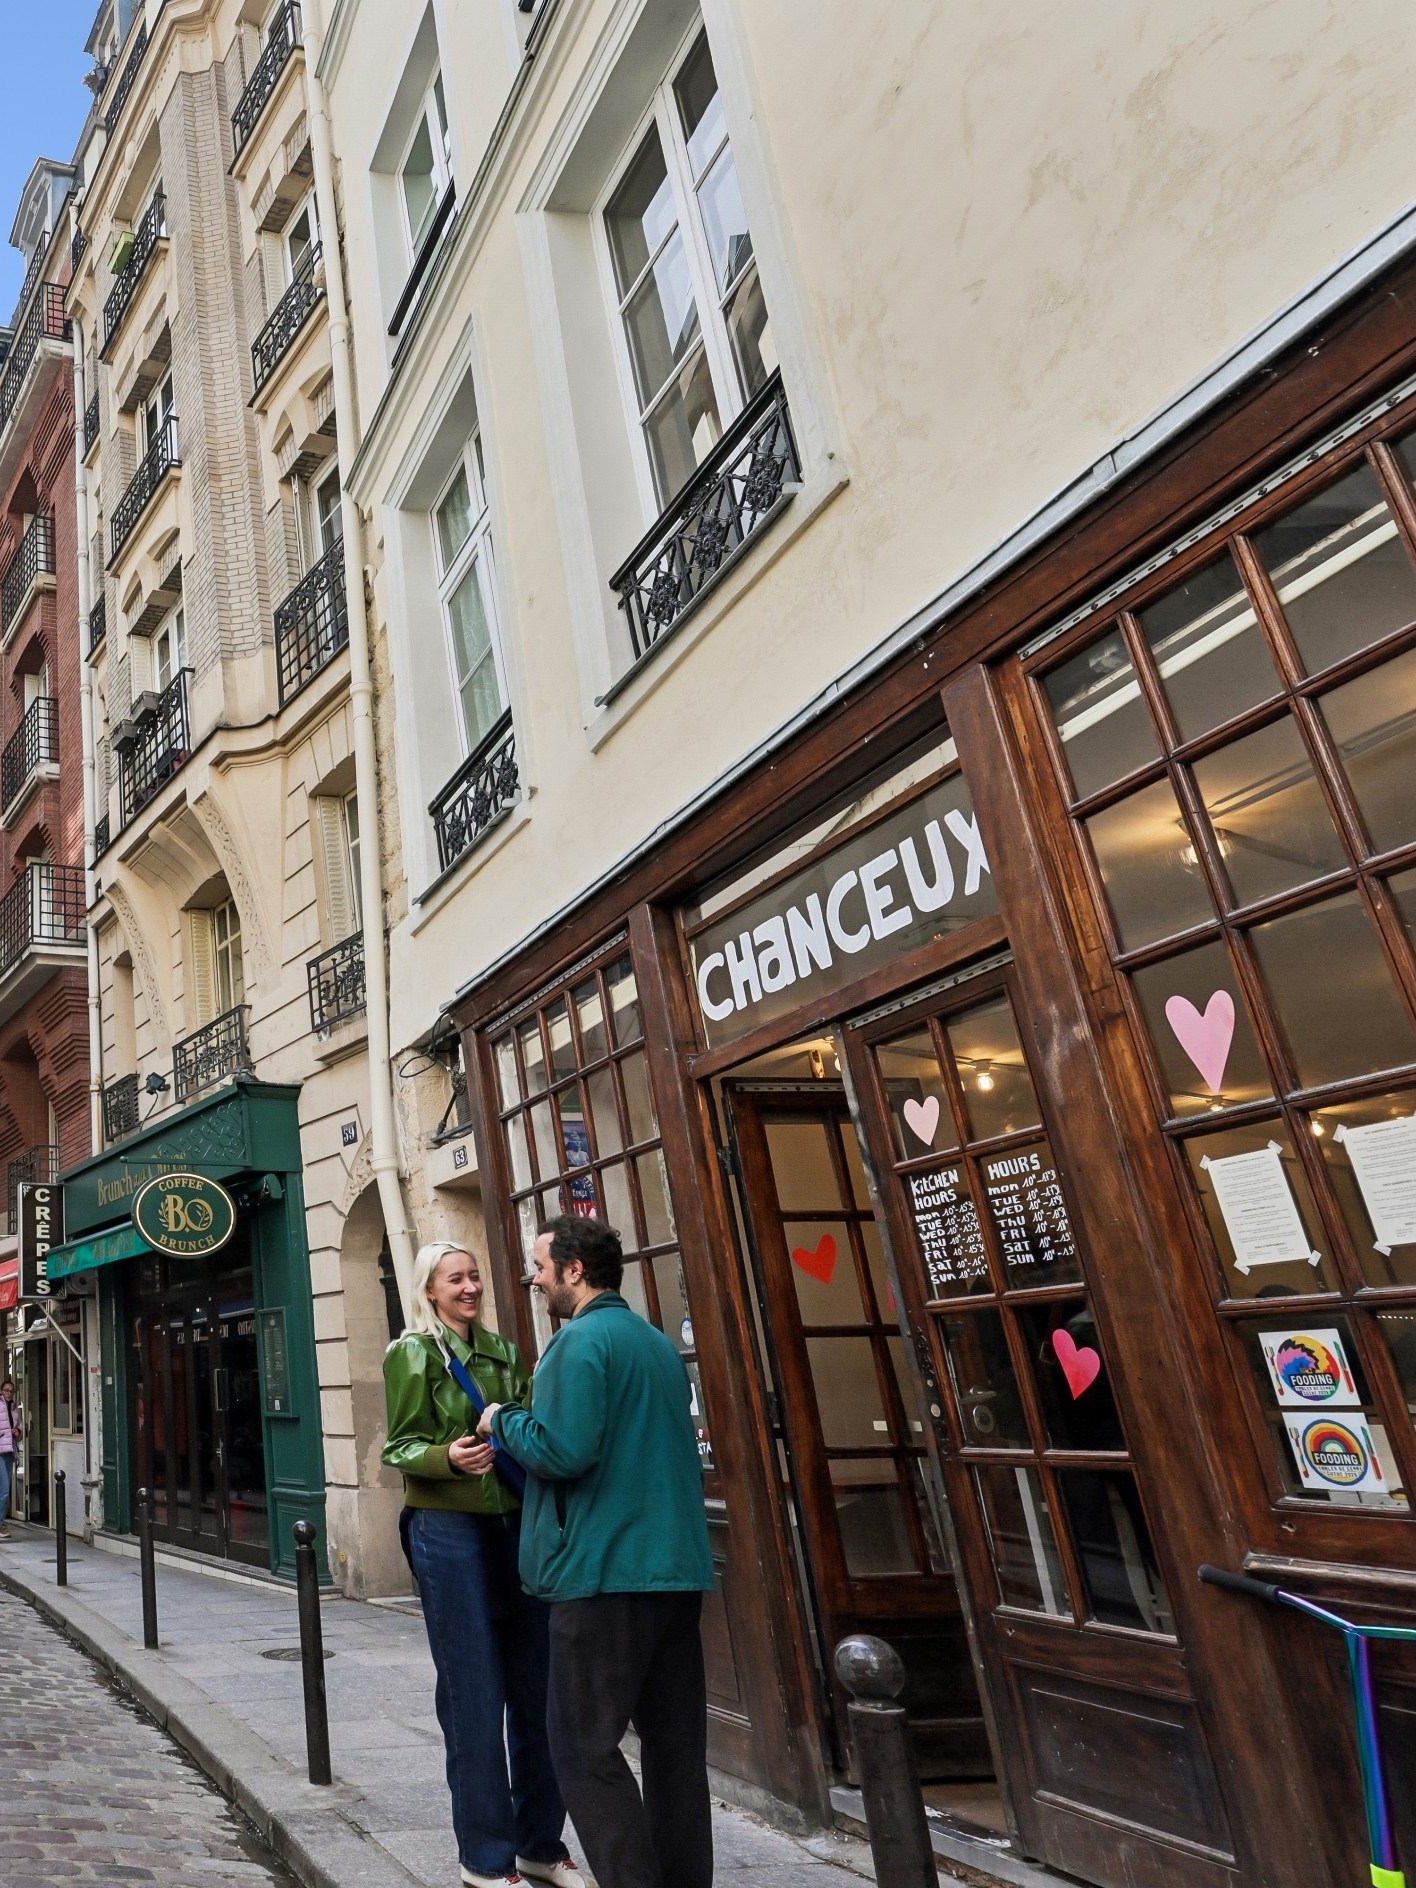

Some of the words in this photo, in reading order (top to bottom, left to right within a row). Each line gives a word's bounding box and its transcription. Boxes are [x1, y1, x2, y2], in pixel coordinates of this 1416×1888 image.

[343, 1126, 356, 1143] 59
[454, 1150, 466, 1164] 63
[988, 1153, 1041, 1180] HOURS
[97, 1165, 134, 1207] Brunch
[158, 1178, 204, 1192] COFFEE
[988, 1183, 1019, 1195] mon
[915, 1189, 957, 1210] HOURS
[991, 1195, 1021, 1207] TUE
[993, 1205, 1024, 1216] WED
[918, 1220, 942, 1232] TUE
[34, 1188, 51, 1295] CRÊPES
[919, 1228, 945, 1241] WED
[158, 1234, 216, 1251] BRUNCH
[1290, 1374, 1333, 1386] FOODING
[1314, 1453, 1358, 1465] FOODING
